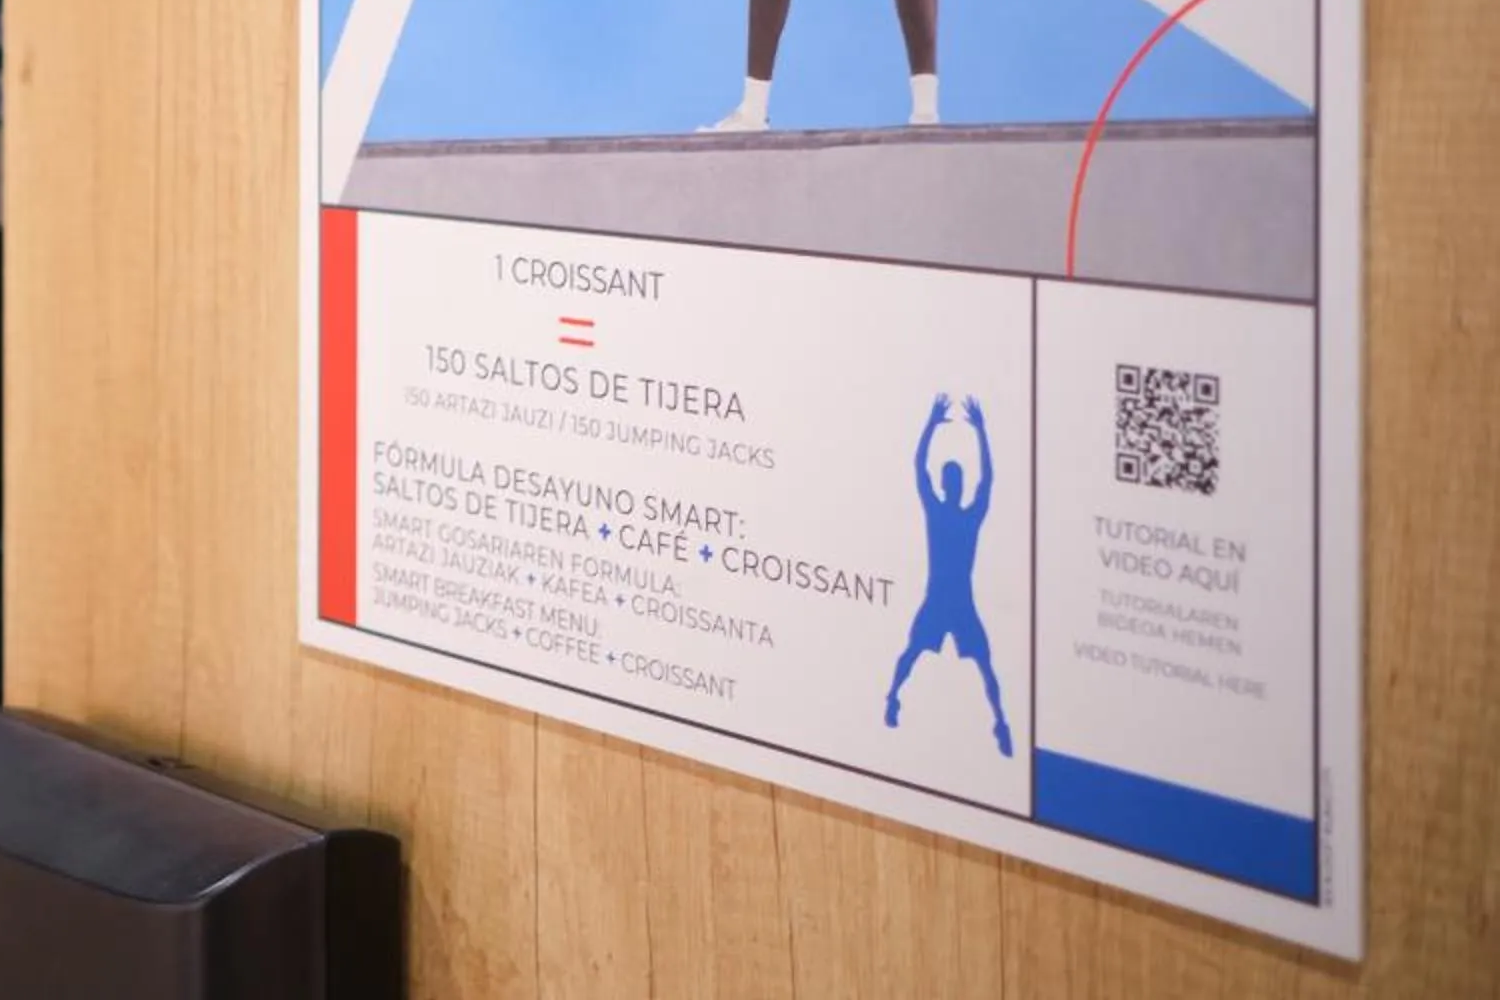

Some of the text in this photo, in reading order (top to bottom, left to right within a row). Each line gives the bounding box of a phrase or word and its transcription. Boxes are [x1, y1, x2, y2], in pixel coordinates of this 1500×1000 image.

[494, 254, 665, 301] 1 CROISSANT
[425, 345, 745, 422] 150 SALTOS DE TIJERA
[434, 394, 497, 419] ARTAZI
[501, 404, 553, 431] JAUZI
[571, 415, 599, 440] 150
[605, 421, 701, 457] JUMPING
[706, 439, 775, 470] JACKS
[373, 441, 745, 540] FÓRMULA DESAYUNO SMART:
[372, 508, 431, 539] SMART
[437, 523, 563, 570] GOSARIAREN
[373, 471, 458, 512] SALTOS
[465, 491, 497, 520] DE
[505, 499, 590, 540] TIJERA
[619, 524, 689, 562] CAFÉ
[721, 547, 896, 607] CROISSANT
[1094, 515, 1247, 563] TUTORIAL EN
[1100, 546, 1173, 581] VIDEO
[372, 561, 430, 594] SMART
[434, 577, 534, 620] BREAKFAST
[372, 533, 435, 565] ARTAZI
[443, 549, 520, 584] JAUZIAK
[542, 574, 607, 605] KAFEA
[631, 594, 774, 649] CROISSANTA
[372, 586, 450, 623] JUMPING
[454, 609, 507, 640] JACKS
[526, 626, 599, 666] COFFEE
[621, 652, 737, 701] CROISSANT
